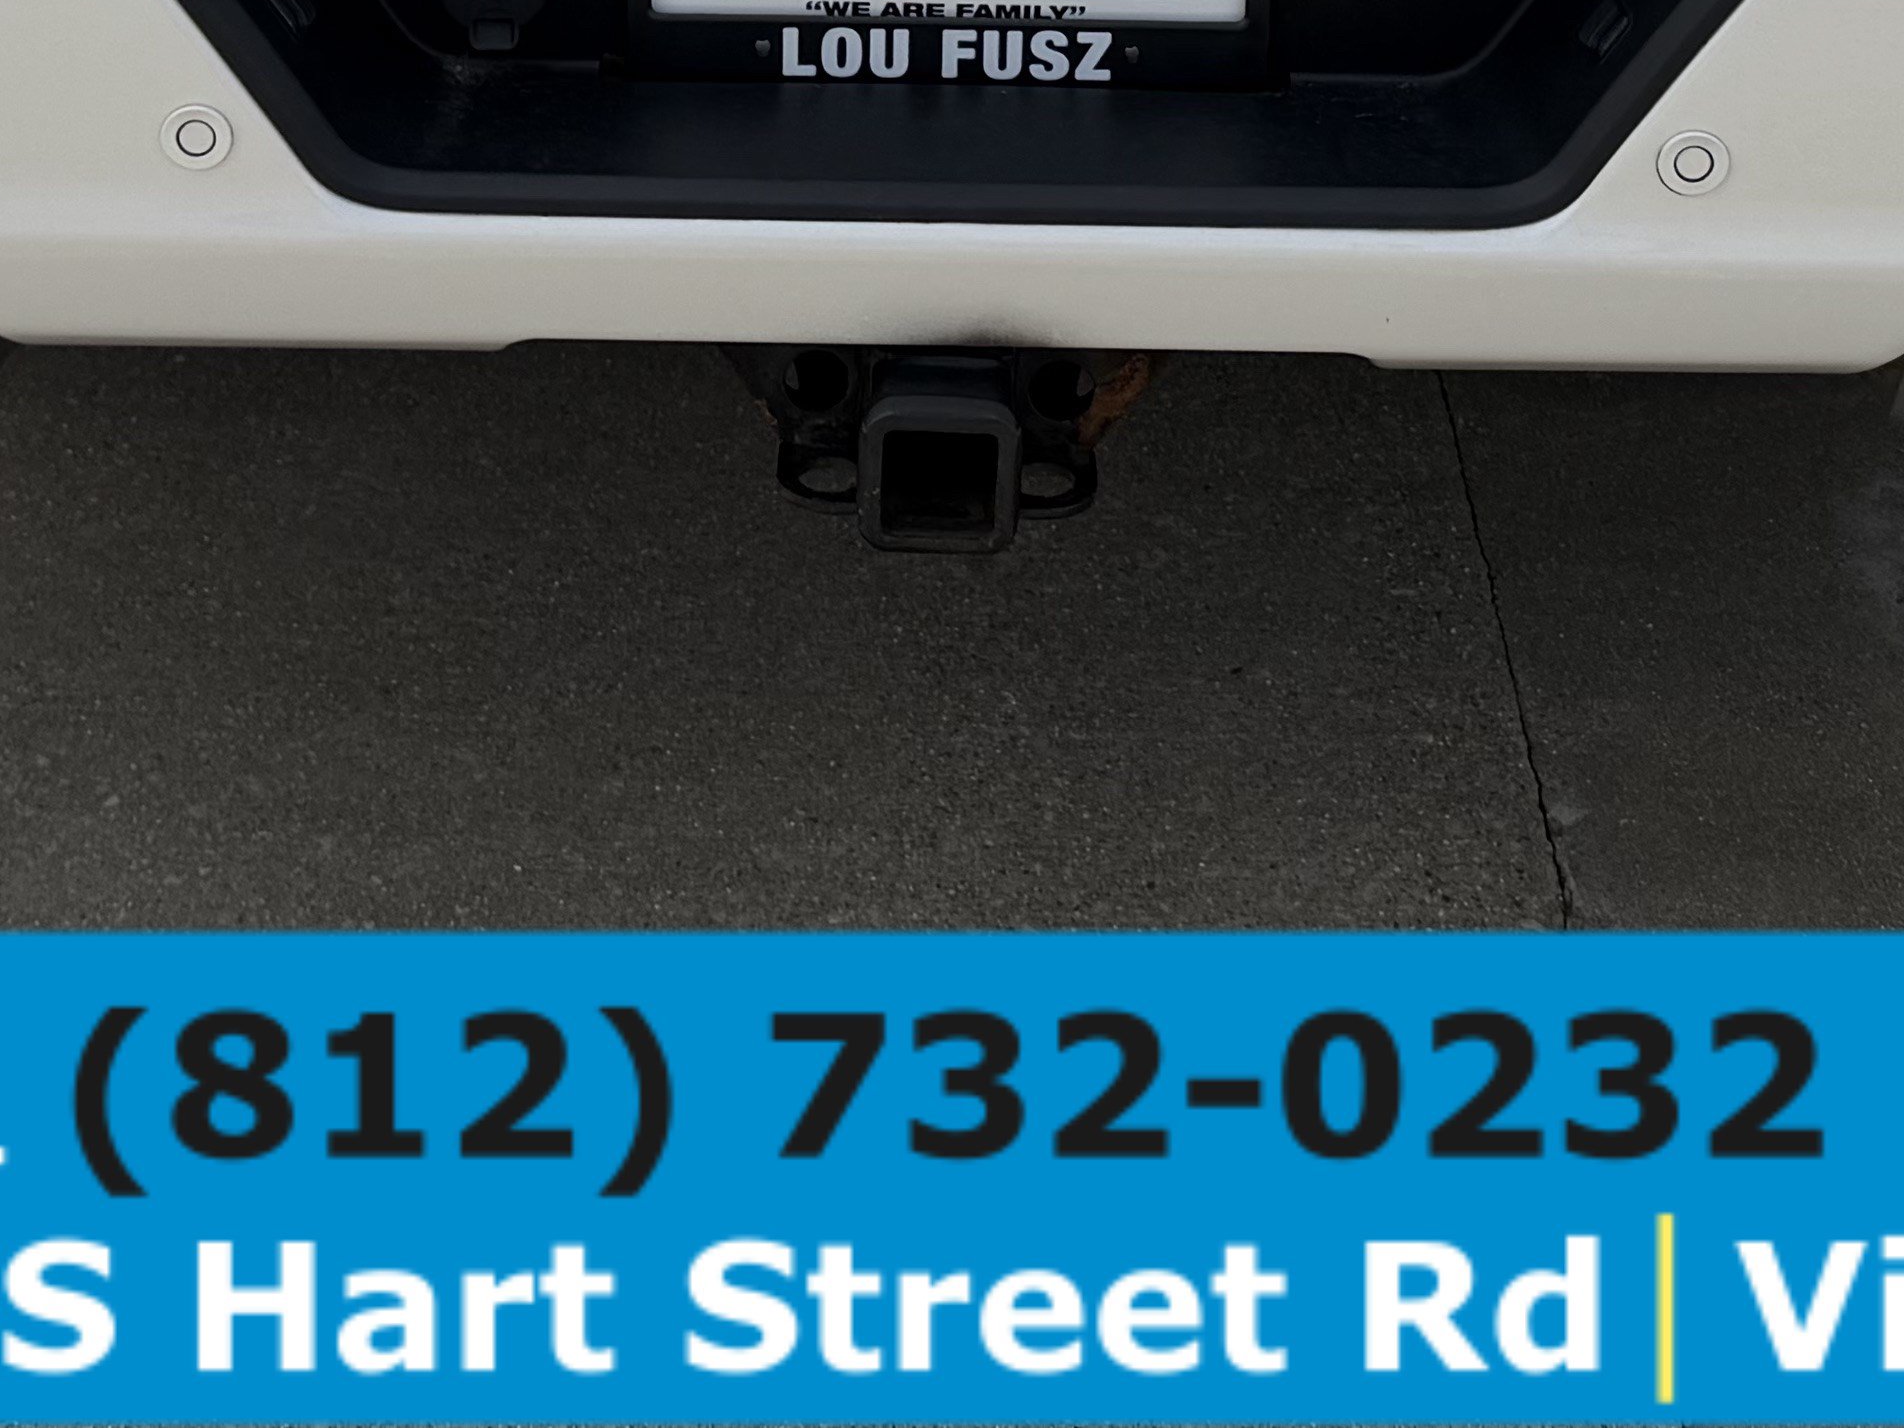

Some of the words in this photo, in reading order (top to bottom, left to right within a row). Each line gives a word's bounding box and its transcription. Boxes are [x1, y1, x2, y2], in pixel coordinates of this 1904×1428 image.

[880, 2, 946, 19] ARE
[782, 26, 910, 79] LOU
[941, 28, 1113, 81] FUSZ
